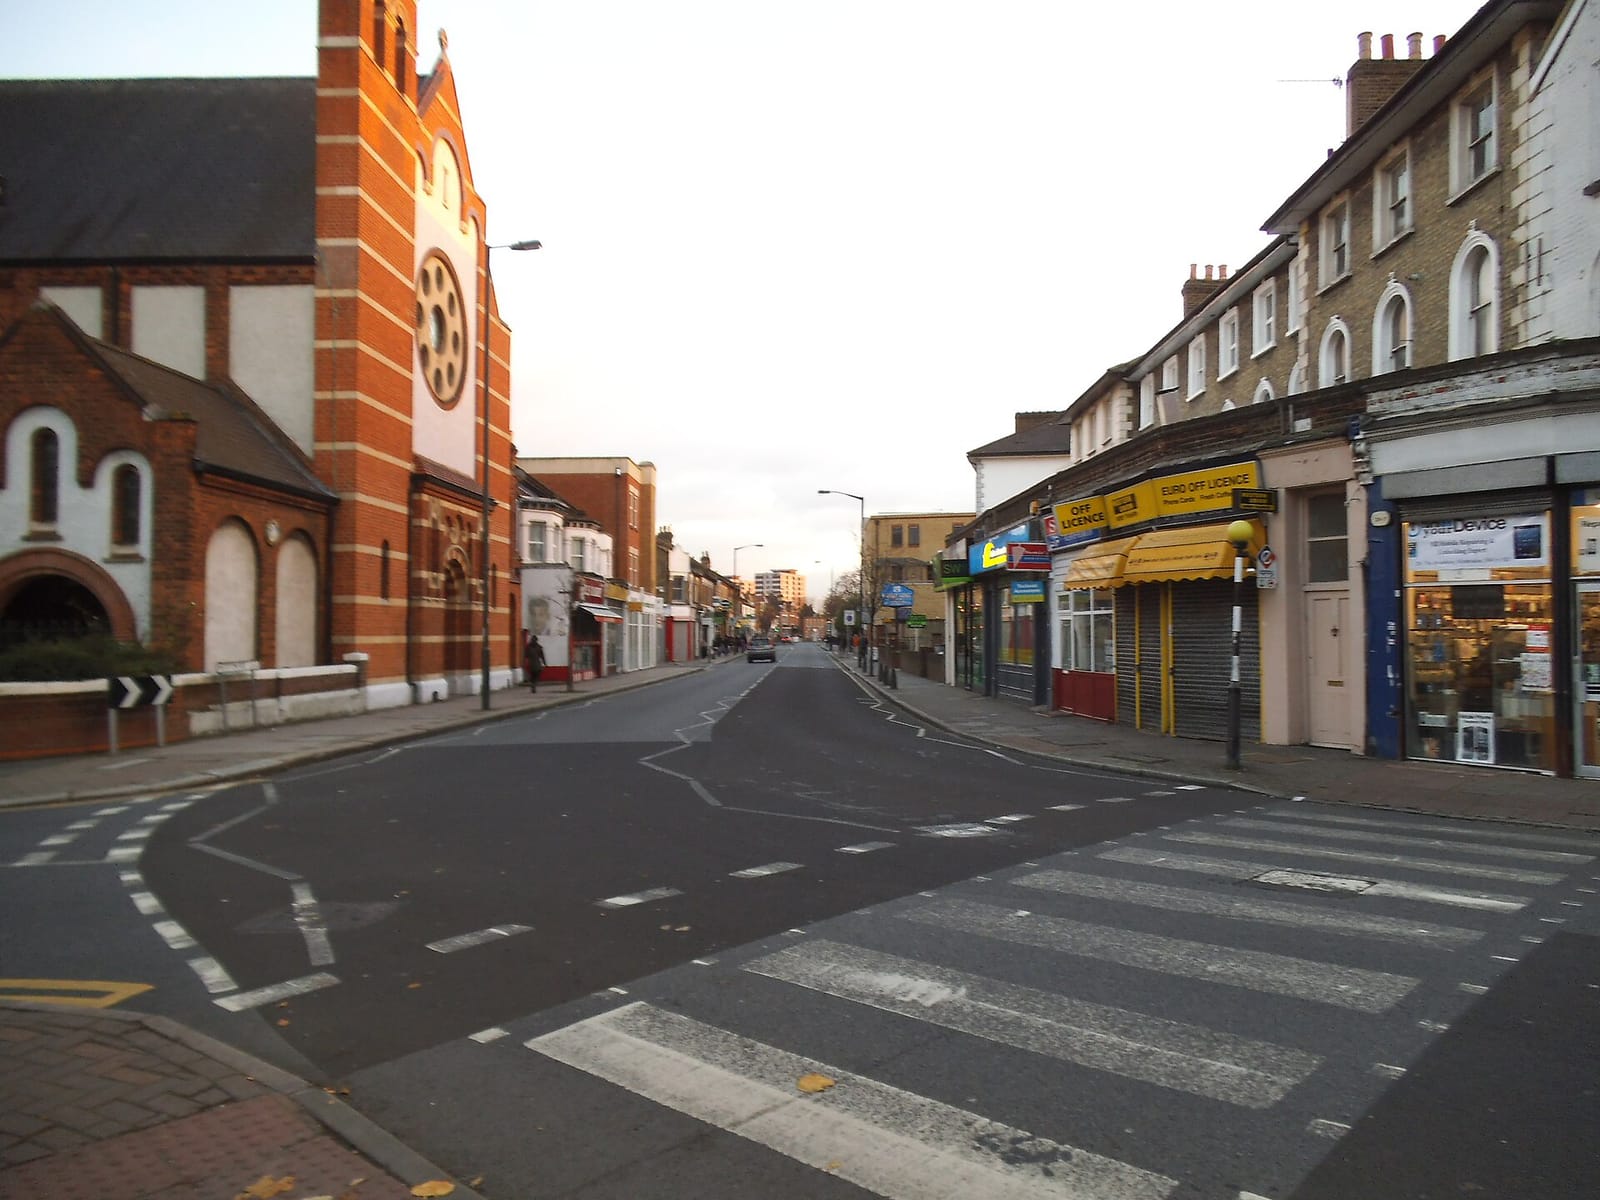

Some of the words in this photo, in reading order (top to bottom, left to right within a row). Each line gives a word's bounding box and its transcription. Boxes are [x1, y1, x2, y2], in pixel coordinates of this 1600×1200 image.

[1161, 484, 1186, 496] EURO
[1188, 480, 1207, 491] OFF
[1208, 473, 1250, 489] LICENCE
[1070, 503, 1092, 516] OFF
[1061, 512, 1105, 529] LICENCE
[1453, 518, 1507, 532] Device
